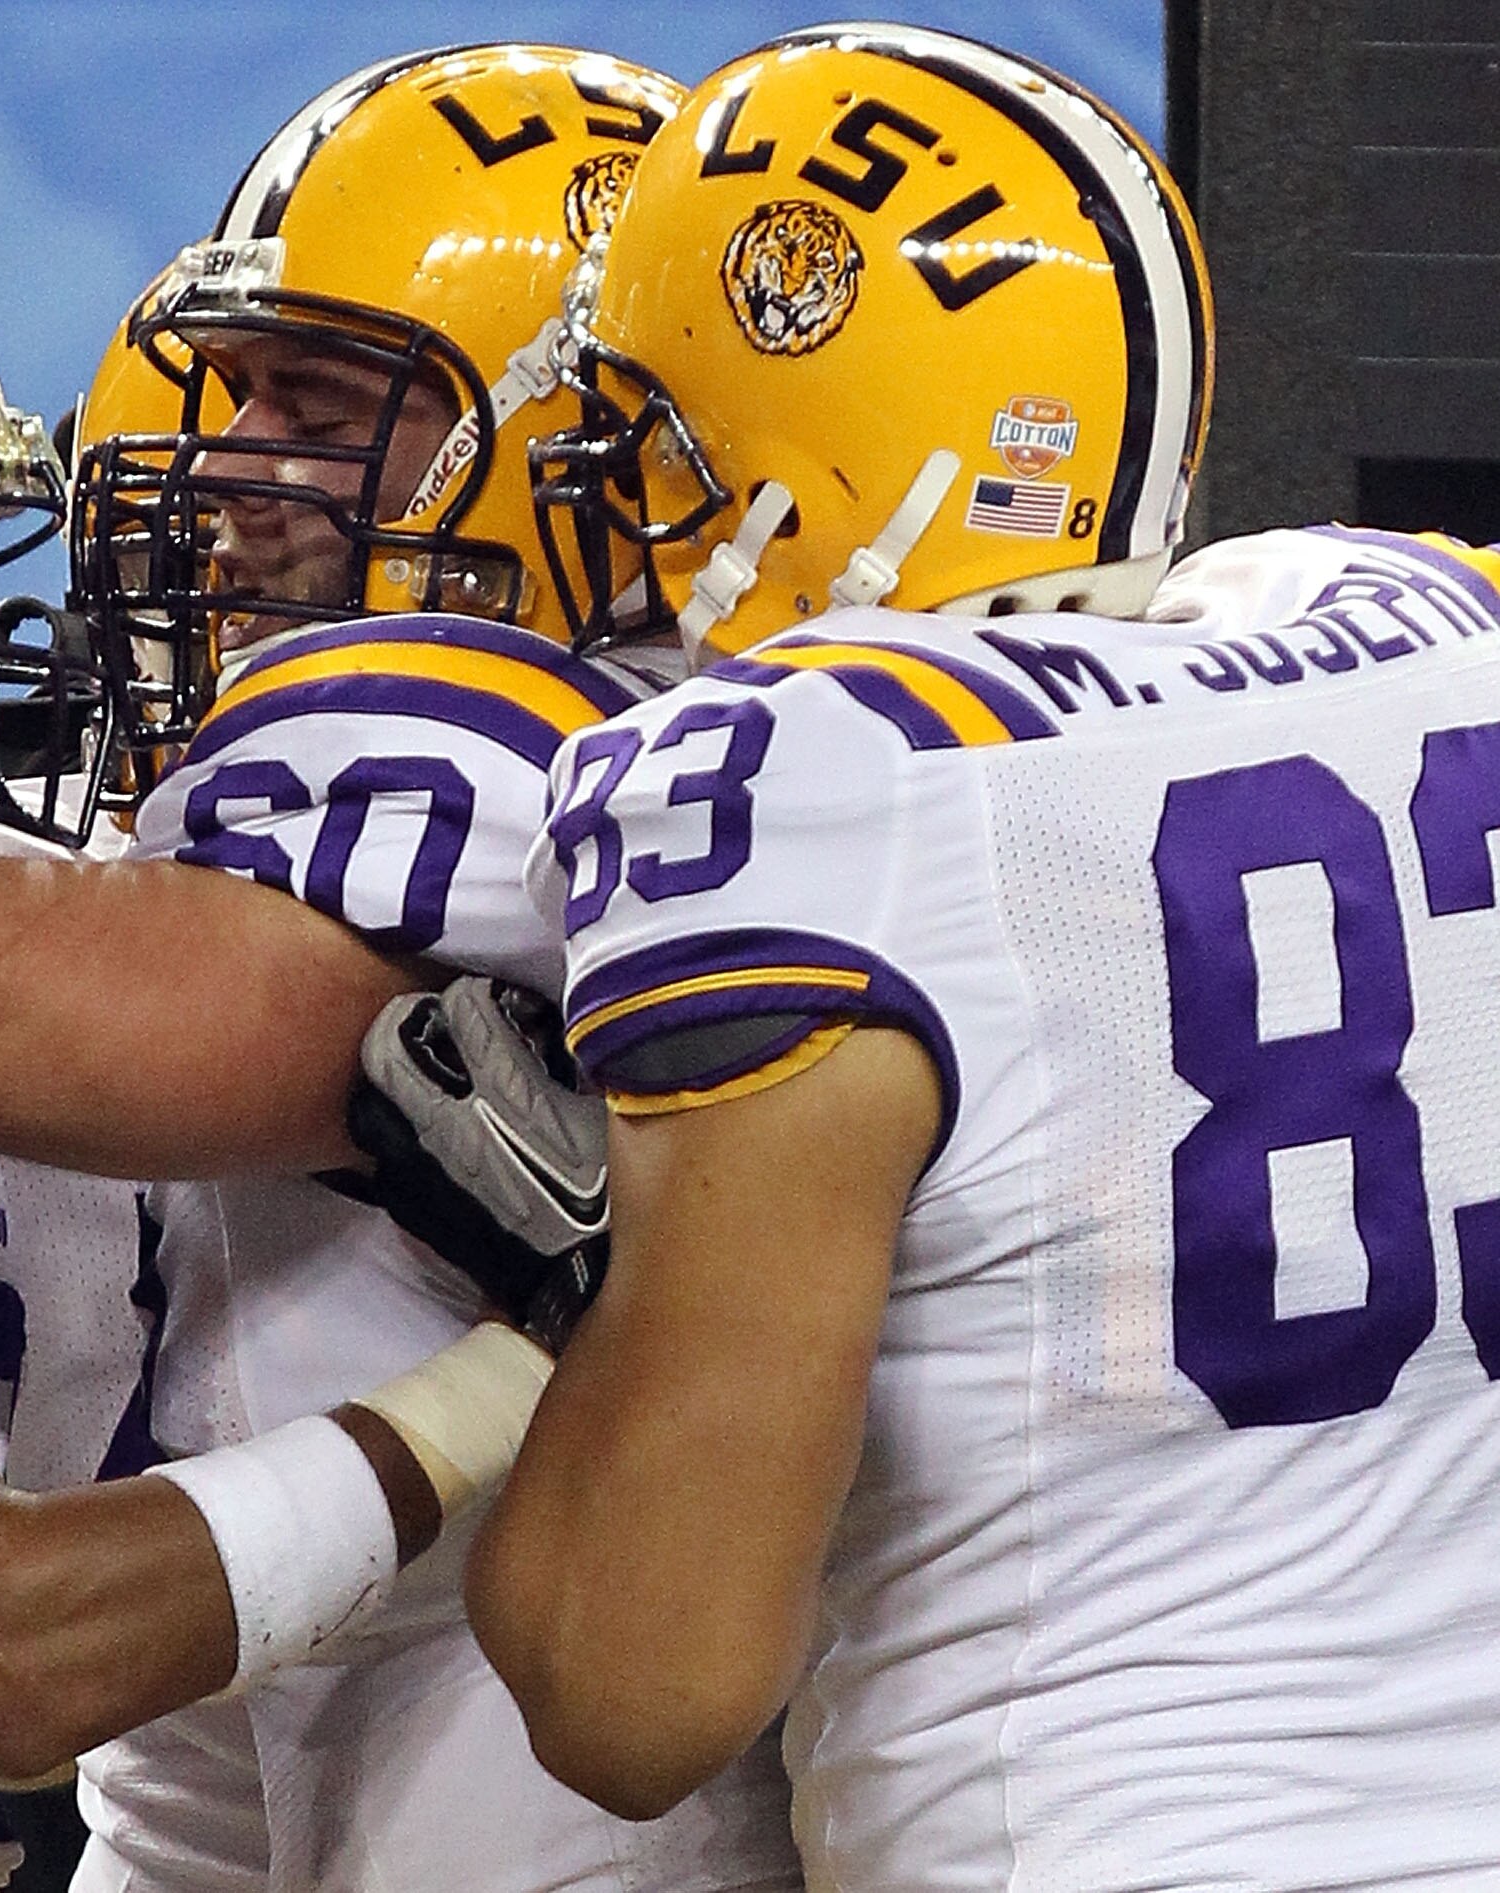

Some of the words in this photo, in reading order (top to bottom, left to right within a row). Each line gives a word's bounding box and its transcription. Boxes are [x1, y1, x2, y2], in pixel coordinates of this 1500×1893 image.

[432, 72, 664, 167] LS
[699, 84, 1038, 312] LSU
[995, 416, 1076, 453] COTTON
[1067, 497, 1097, 539] 8
[973, 629, 1164, 714] M.
[175, 755, 476, 954] 60
[545, 697, 778, 940] 83
